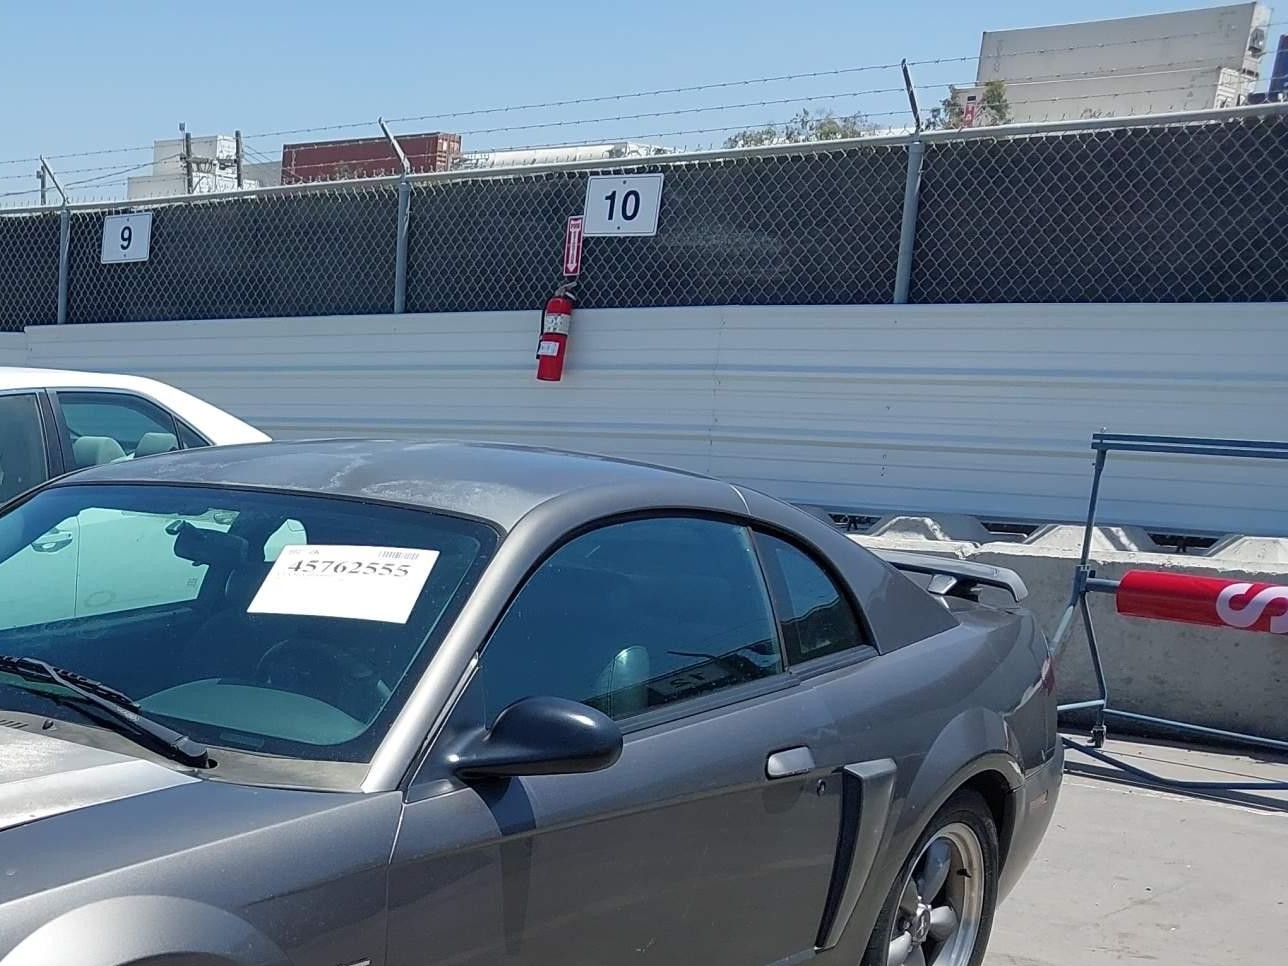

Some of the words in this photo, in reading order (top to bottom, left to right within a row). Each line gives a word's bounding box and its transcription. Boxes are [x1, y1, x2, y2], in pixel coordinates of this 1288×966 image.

[604, 189, 641, 221] 10
[120, 226, 132, 251] 9
[287, 559, 412, 578] 45762555
